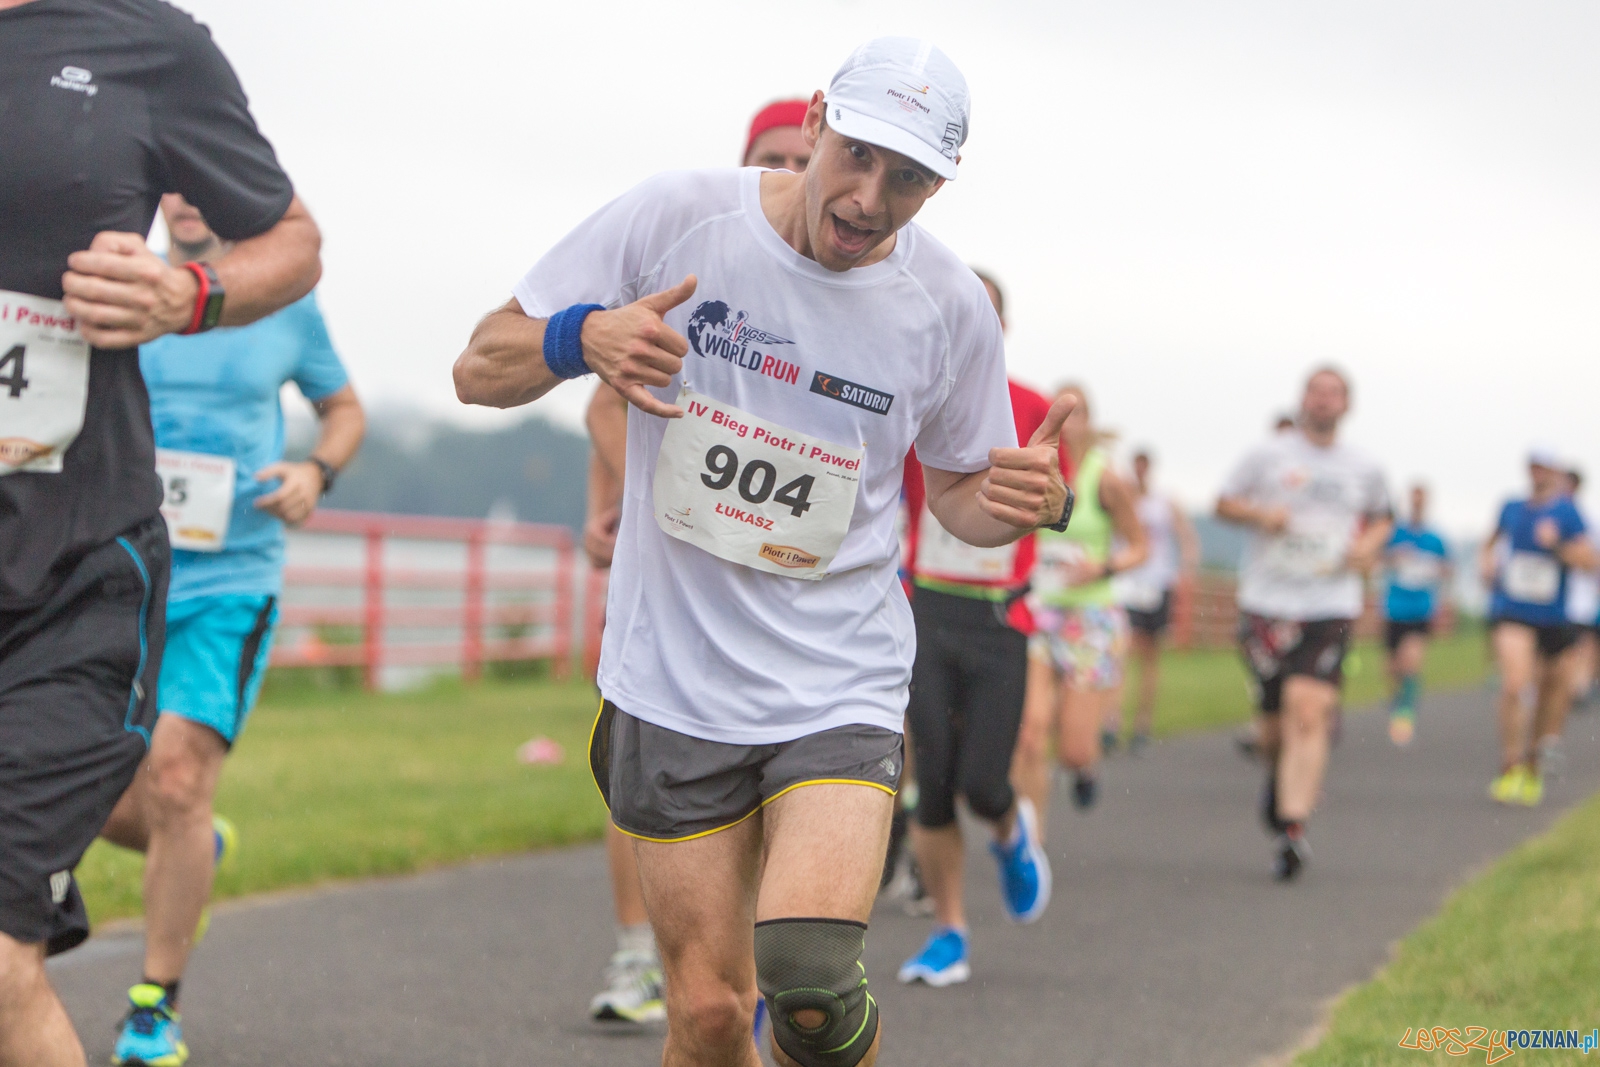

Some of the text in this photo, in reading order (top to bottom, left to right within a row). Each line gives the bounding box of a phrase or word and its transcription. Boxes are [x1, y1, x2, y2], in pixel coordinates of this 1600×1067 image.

[887, 88, 906, 99] Piotr
[2, 304, 9, 320] i
[726, 319, 767, 342] WINGS
[705, 332, 800, 385] WORLD RUN
[841, 384, 890, 412] SATURN
[687, 400, 860, 471] IV Bieg Piotr i Paweł
[700, 444, 816, 518] 904
[715, 502, 775, 531] ŁUKASZ
[762, 545, 785, 559] Piotr
[787, 552, 791, 560] i
